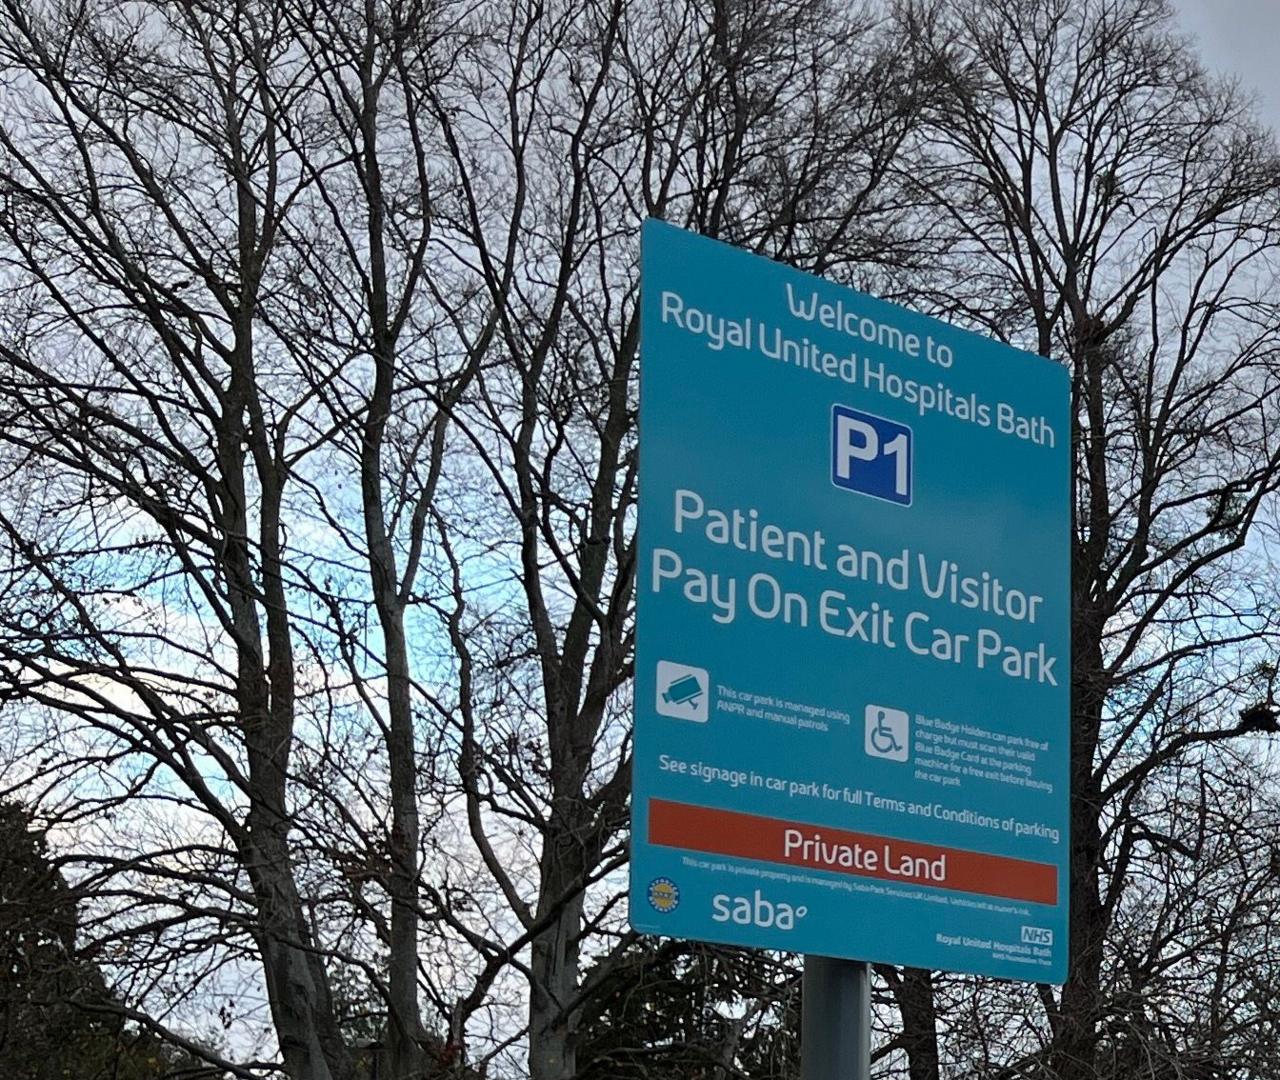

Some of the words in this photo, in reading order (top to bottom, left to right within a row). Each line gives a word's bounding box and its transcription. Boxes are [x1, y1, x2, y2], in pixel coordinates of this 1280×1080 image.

[786, 283, 920, 357] Welcome
[927, 336, 953, 368] to
[662, 291, 750, 350] Royal
[760, 323, 856, 384] United
[864, 358, 990, 426] Hospitals
[997, 403, 1054, 448] Bath
[836, 414, 908, 496] P1
[675, 489, 827, 570] Patient
[837, 544, 908, 590] and
[918, 553, 1043, 623] Visitor
[652, 548, 735, 624] Pay
[748, 573, 808, 627] On
[820, 590, 896, 648] Exit
[905, 611, 969, 663] Car
[977, 629, 1058, 686] Park
[717, 685, 736, 699] This
[738, 691, 752, 701] car
[754, 694, 774, 707] park
[775, 700, 783, 708] is
[785, 701, 825, 718] managed
[826, 710, 850, 724] using
[717, 700, 744, 714] ANPR
[746, 707, 763, 719] and
[765, 712, 797, 725] manual
[798, 718, 828, 731] patrols
[659, 754, 687, 773] See
[690, 762, 747, 787] signage
[750, 771, 763, 787] in
[766, 777, 788, 790] car
[790, 782, 820, 797] park
[822, 784, 841, 800] for
[843, 788, 862, 804] full
[865, 792, 905, 812] Terms
[908, 801, 931, 816] and
[933, 804, 999, 829] Conditions
[1002, 818, 1014, 831] of
[1015, 821, 1059, 844] parking
[785, 829, 878, 871] Private
[884, 846, 946, 881] Land
[936, 933, 961, 946] Royal
[963, 937, 992, 948] United
[993, 942, 1031, 955] Hospitals
[1033, 947, 1051, 957] Bath
[1023, 927, 1050, 943] NHS
